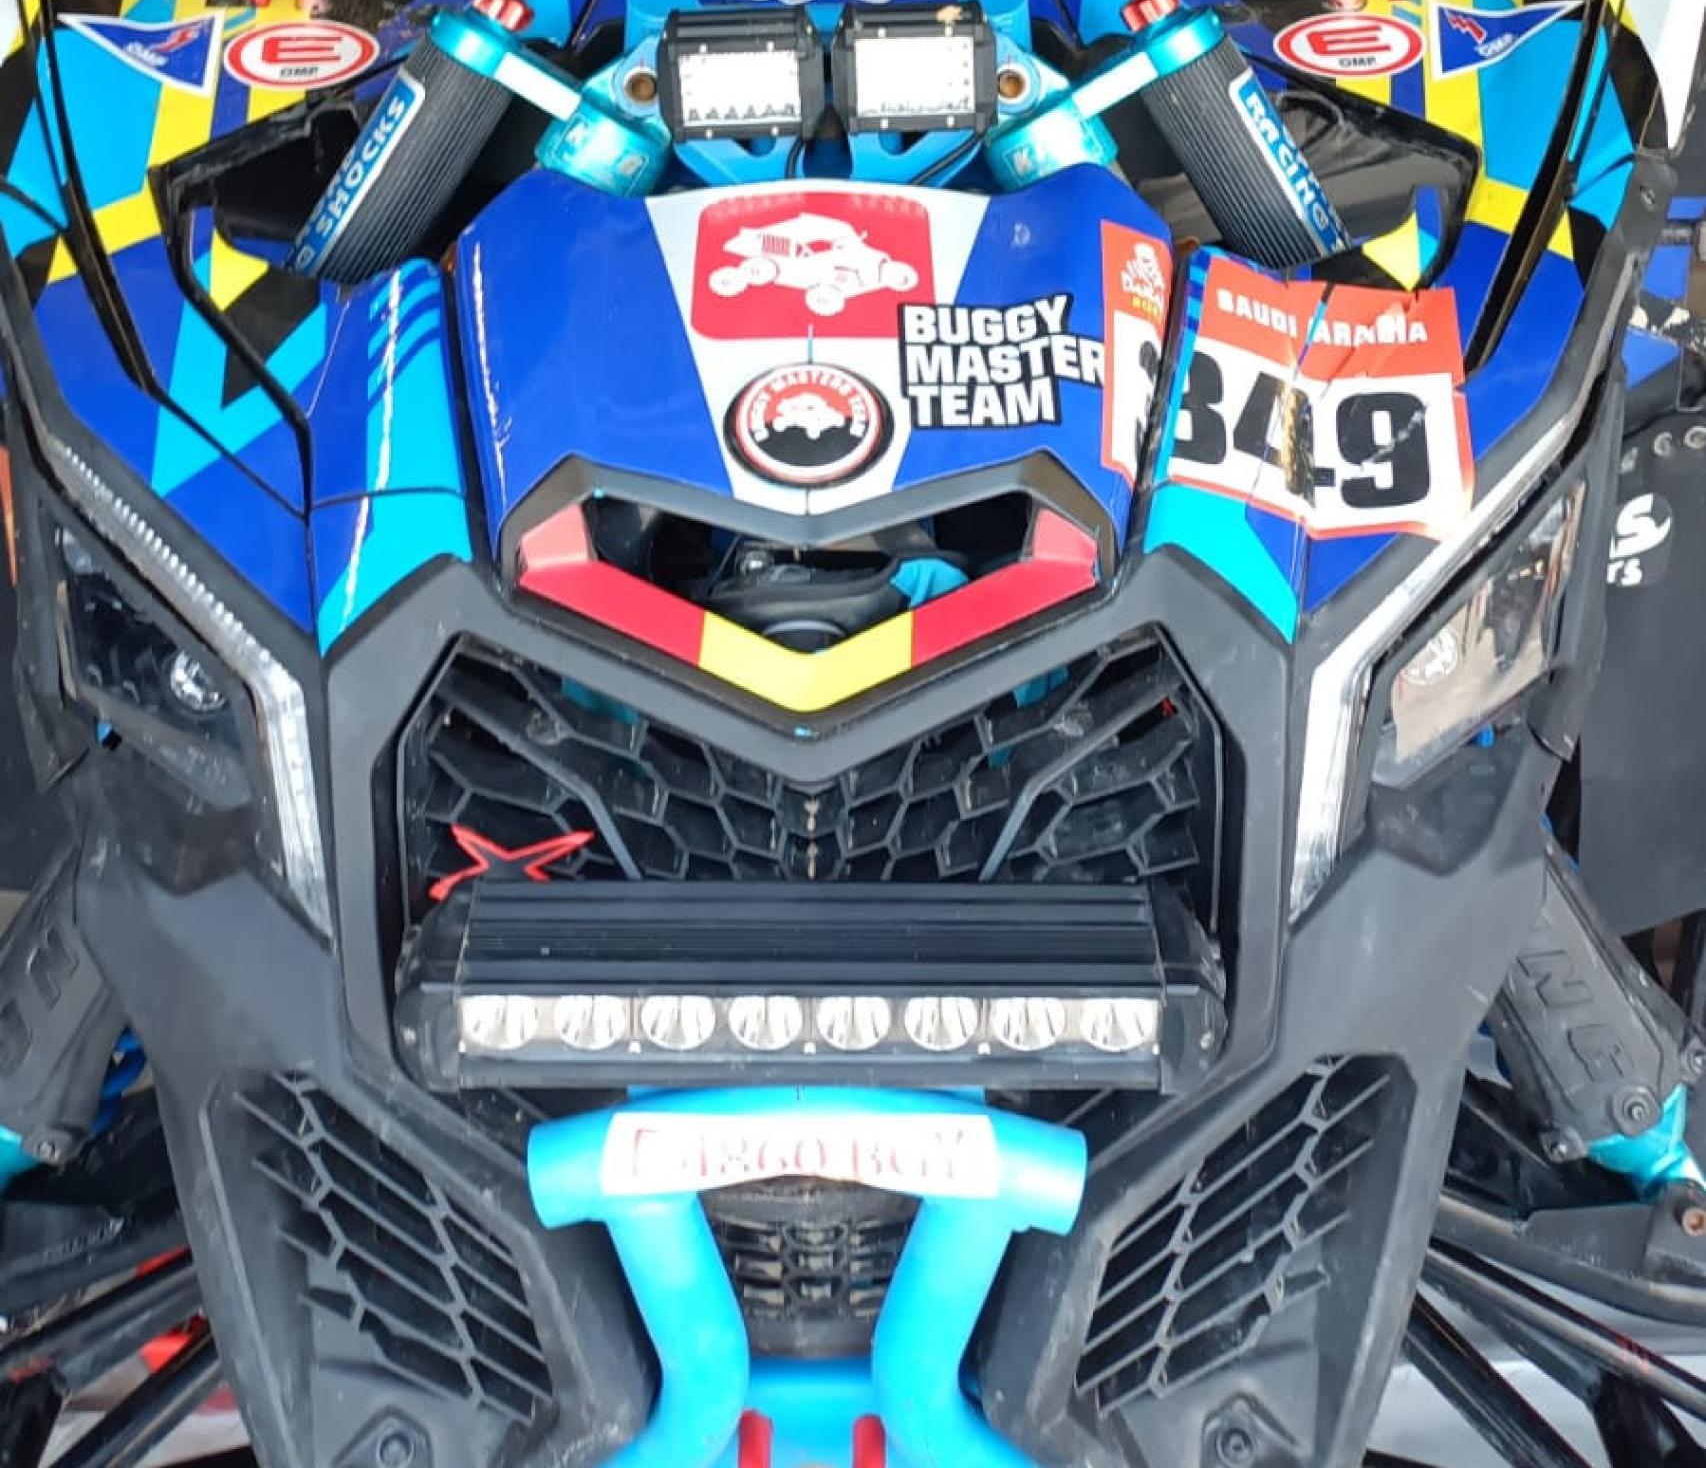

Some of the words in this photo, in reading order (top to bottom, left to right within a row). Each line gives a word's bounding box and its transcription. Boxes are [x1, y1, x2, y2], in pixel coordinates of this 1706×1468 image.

[314, 87, 406, 238] SHOCKS
[904, 294, 1068, 344] BUGGY
[1216, 288, 1298, 339] SAUDI
[906, 336, 1105, 385] MASTER
[908, 377, 1056, 426] TEAM
